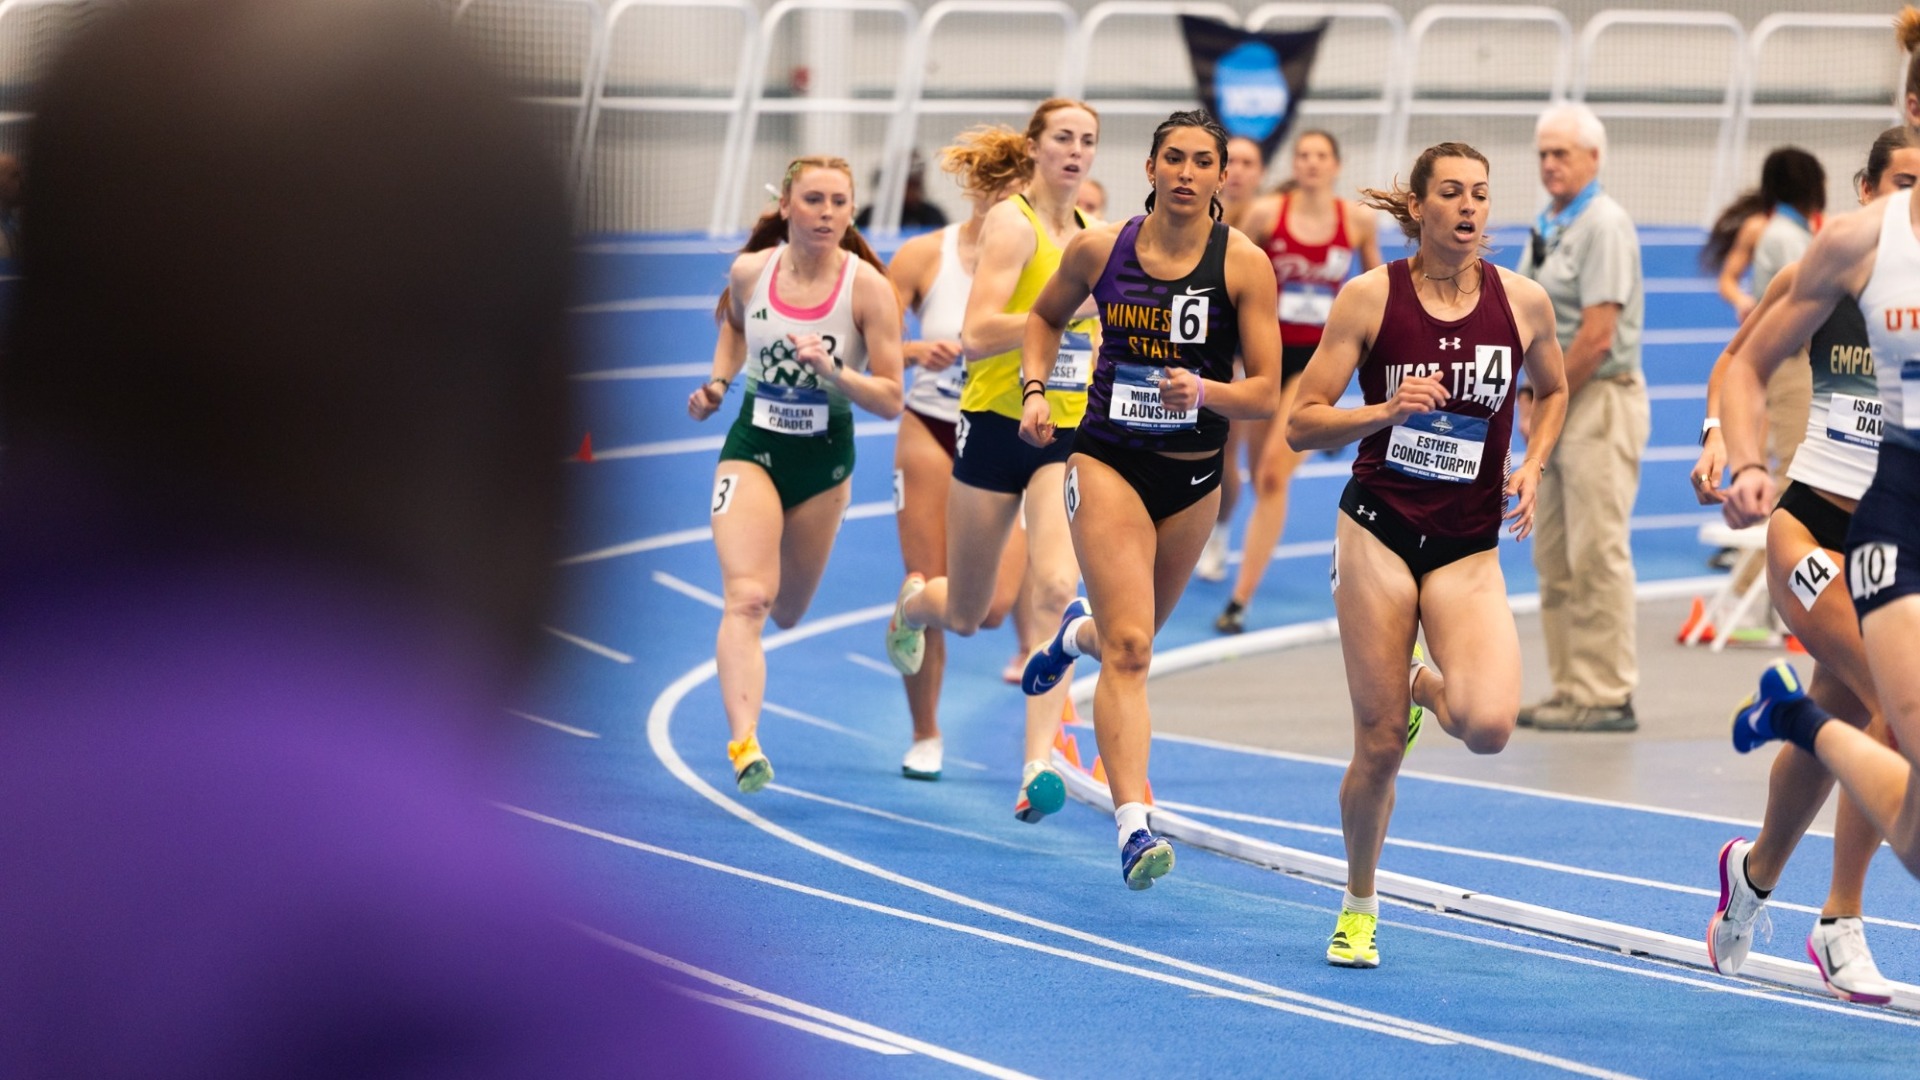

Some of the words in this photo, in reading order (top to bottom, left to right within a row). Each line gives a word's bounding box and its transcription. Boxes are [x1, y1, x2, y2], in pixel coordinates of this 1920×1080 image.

[1106, 302, 1173, 333] MINNES
[1179, 298, 1201, 341] 6
[1128, 336, 1183, 359] STATE
[1051, 366, 1078, 378] SSEY
[1482, 349, 1506, 395] 4
[1131, 390, 1161, 404] MIRA
[1853, 399, 1882, 416] ISAB
[769, 416, 813, 431] CARDER
[1391, 443, 1477, 476] CONDE-TURPIN
[1416, 435, 1459, 455] ESTHER
[713, 478, 731, 513] 3
[1067, 472, 1076, 513] 6
[1794, 555, 1831, 597] 14
[1859, 545, 1886, 591] 10
